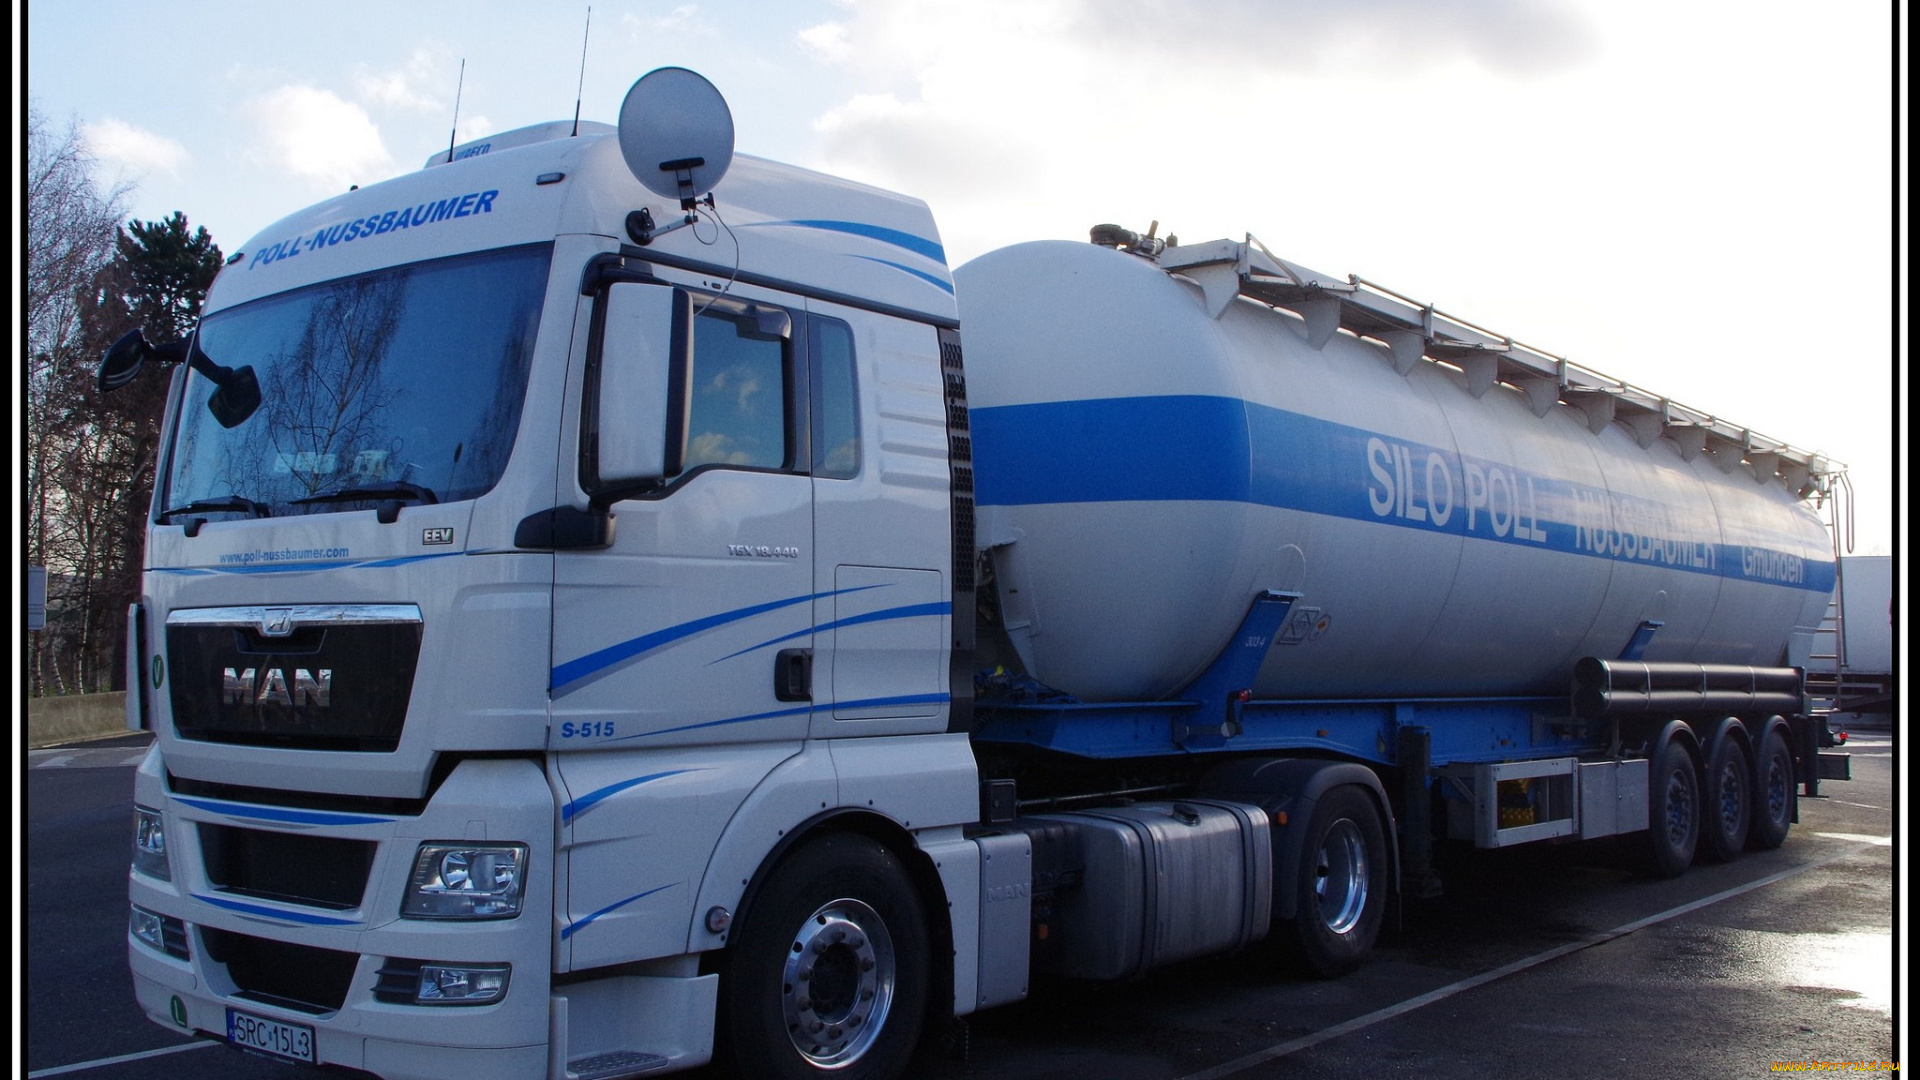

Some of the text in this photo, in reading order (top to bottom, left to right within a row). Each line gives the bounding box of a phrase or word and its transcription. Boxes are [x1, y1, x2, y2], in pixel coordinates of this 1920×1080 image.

[248, 189, 499, 271] POLL-NUSSBAUMER
[1367, 436, 1453, 527] SILO
[1464, 461, 1547, 543] POLL
[424, 528, 452, 544] EEV
[219, 547, 349, 565] www.poll-nussbaumer.com
[223, 667, 332, 707] MAN
[561, 721, 615, 738] S-515
[236, 1015, 267, 1047] SRC
